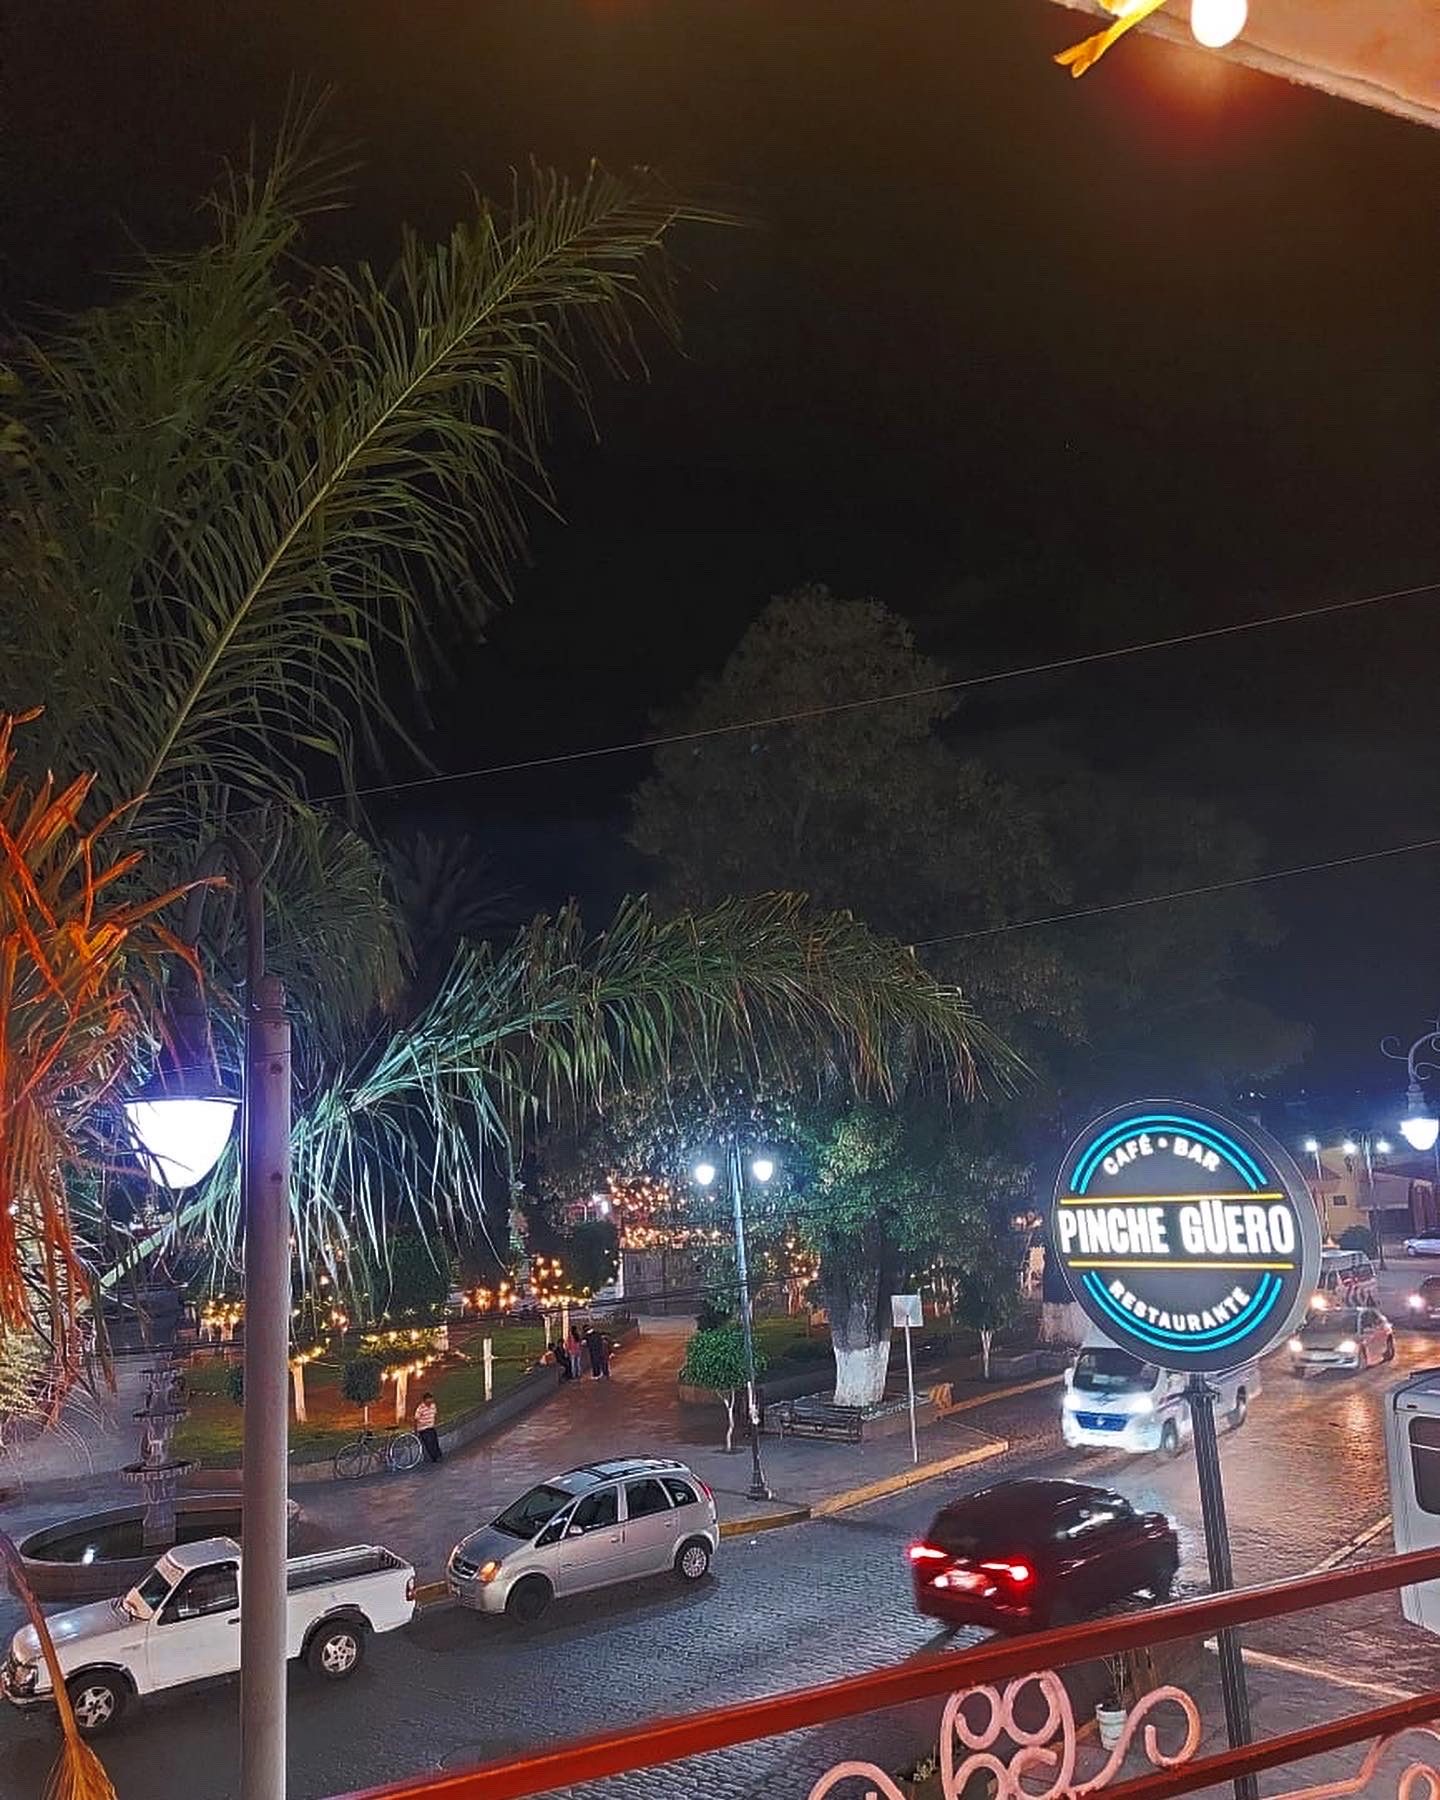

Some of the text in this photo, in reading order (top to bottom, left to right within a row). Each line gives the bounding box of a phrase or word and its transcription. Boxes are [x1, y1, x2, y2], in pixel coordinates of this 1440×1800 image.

[1103, 1134, 1220, 1175] CAFÉ BAR
[1057, 1199, 1295, 1254] PINCHE GÜERO
[1109, 1280, 1250, 1331] RESTAURANTE
